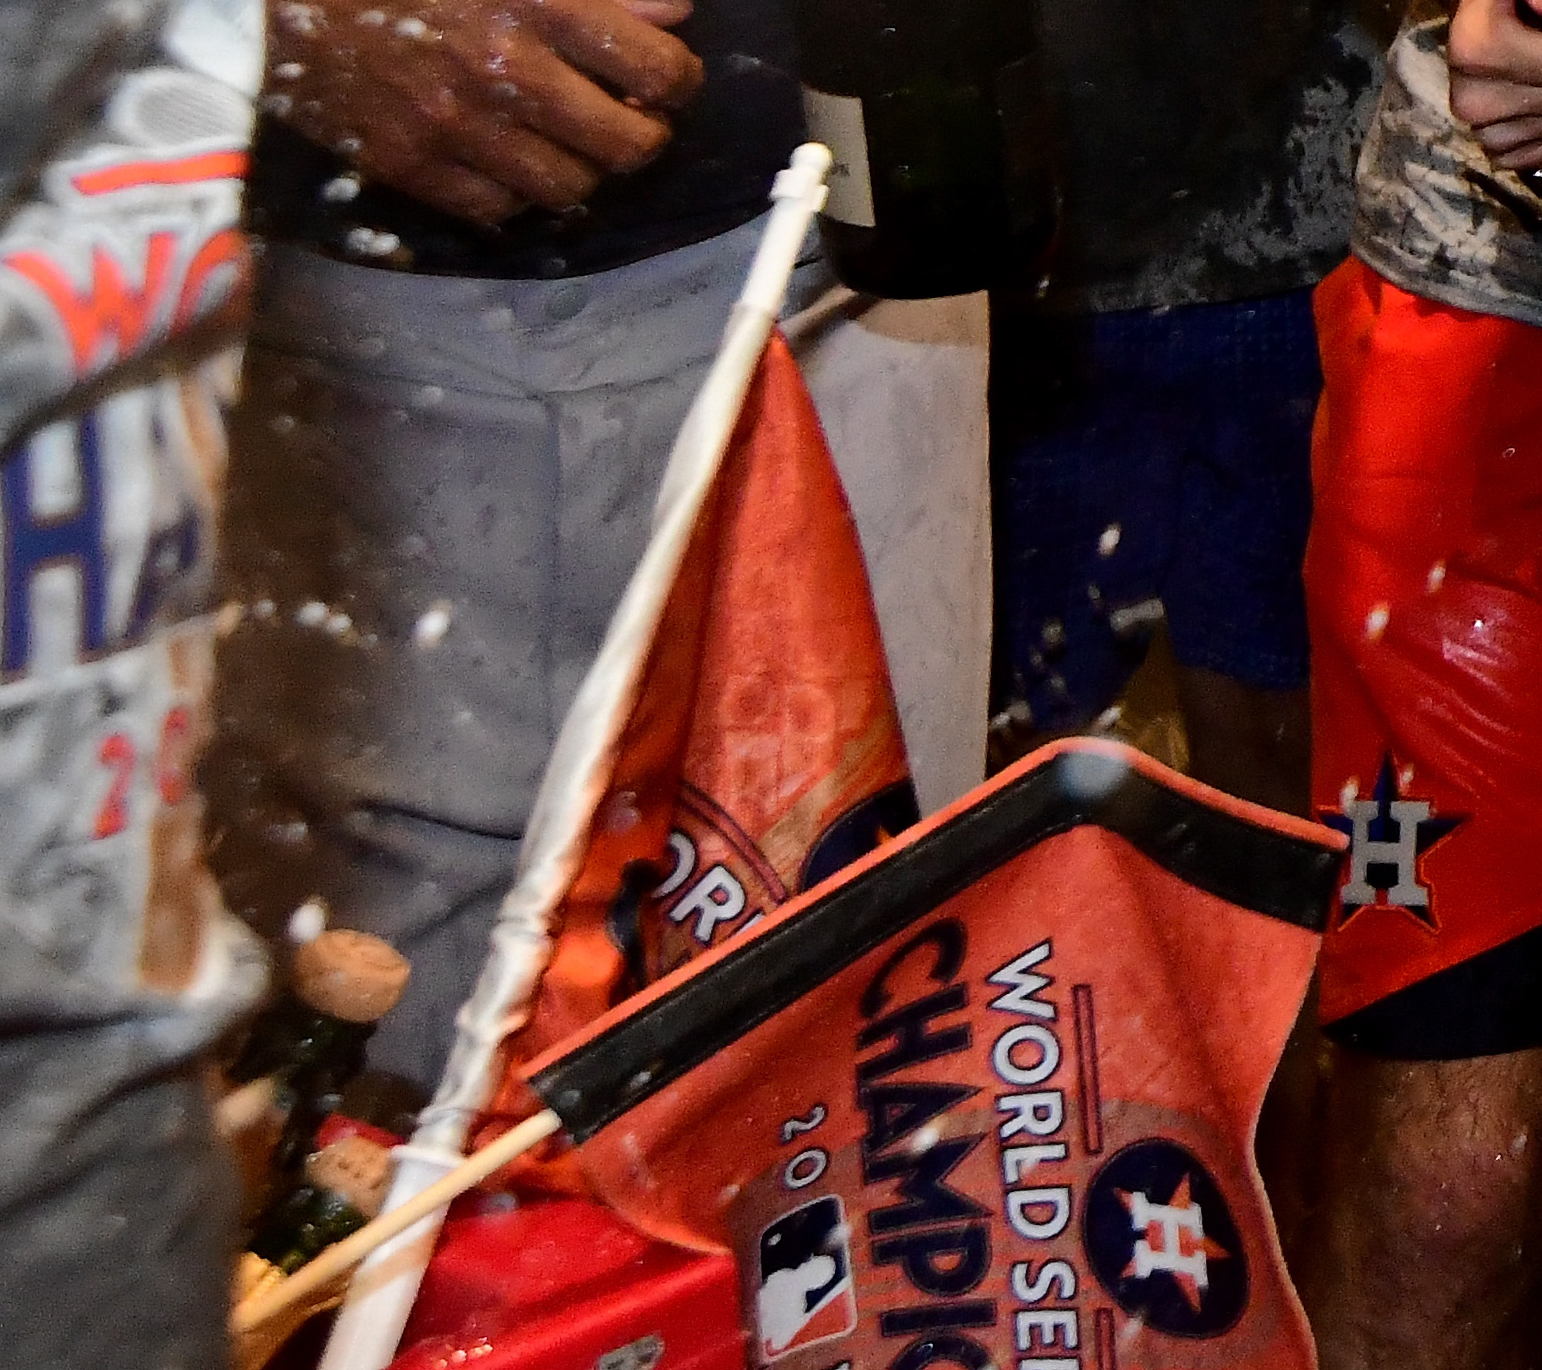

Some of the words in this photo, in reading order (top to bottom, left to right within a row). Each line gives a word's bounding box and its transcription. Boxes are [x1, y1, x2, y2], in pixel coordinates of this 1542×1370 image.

[986, 938, 1074, 1241] WORLD
[780, 1103, 829, 1191] 20
[1011, 1259, 1079, 1370] SE
